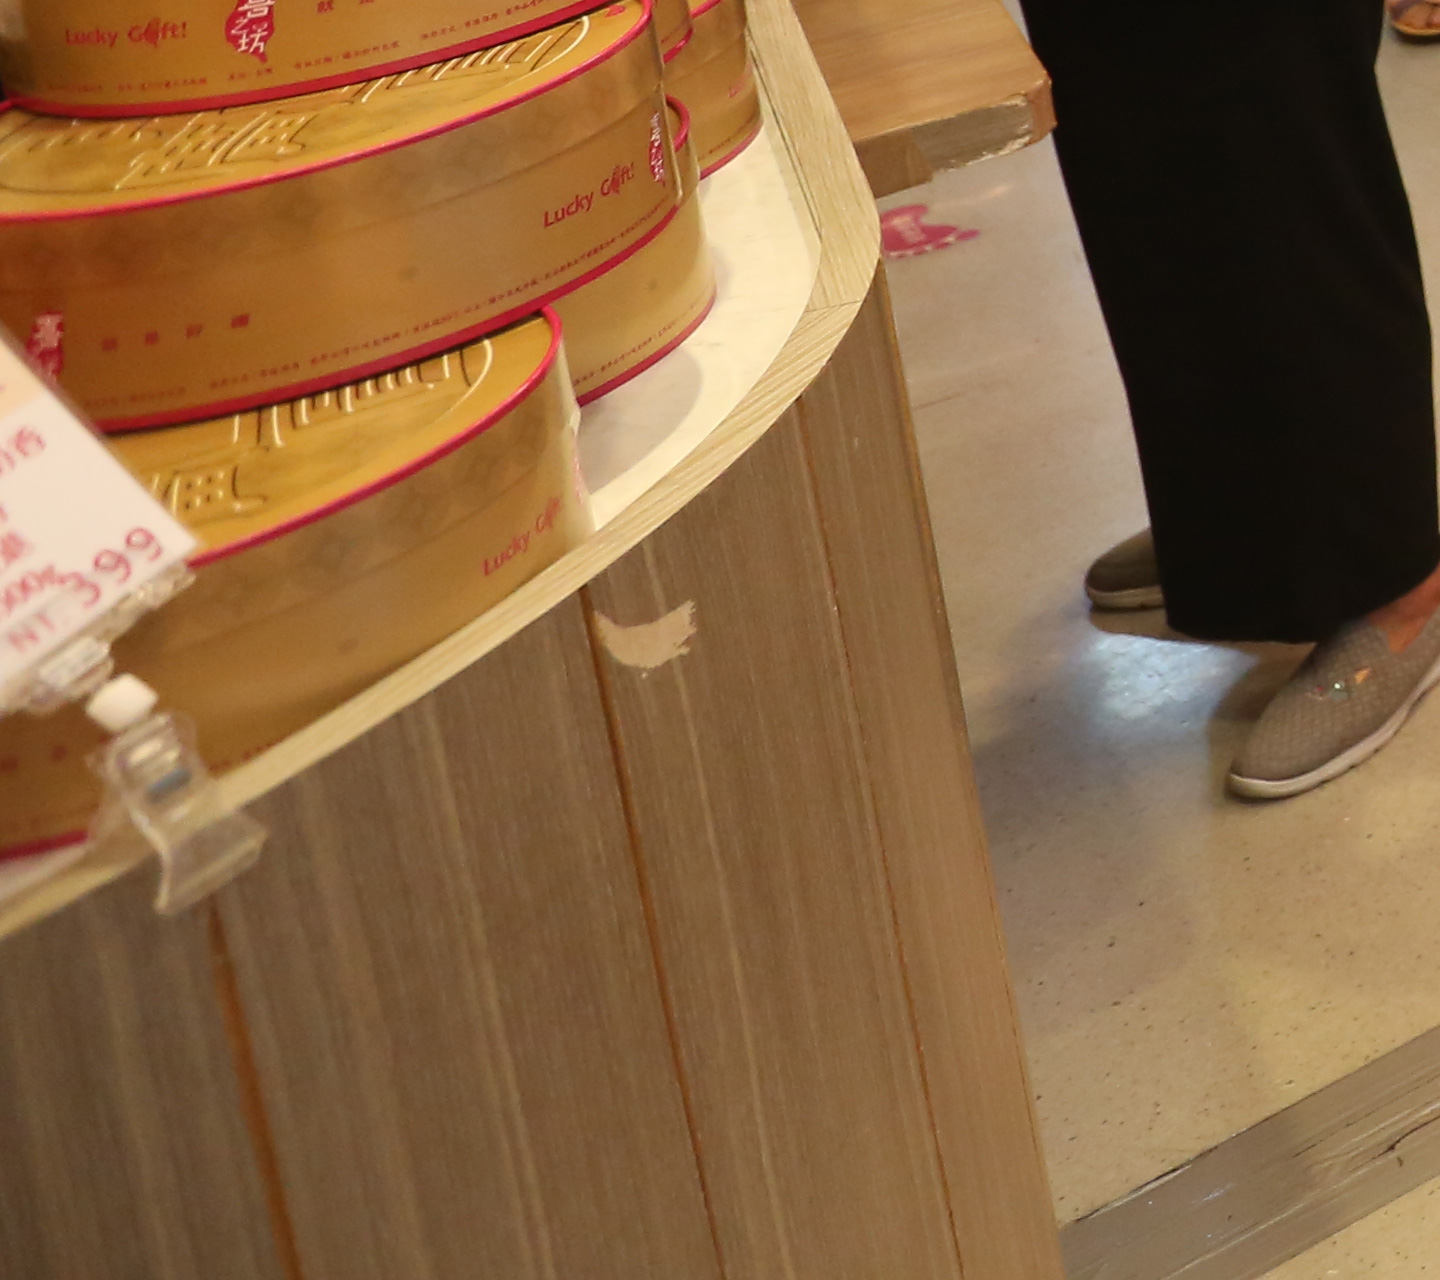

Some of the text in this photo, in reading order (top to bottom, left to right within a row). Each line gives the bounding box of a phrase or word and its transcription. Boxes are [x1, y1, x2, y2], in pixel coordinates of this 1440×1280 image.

[66, 26, 119, 49] Lucky
[543, 191, 594, 229] Lucky
[57, 527, 164, 608] 399
[483, 530, 530, 577] Lucky
